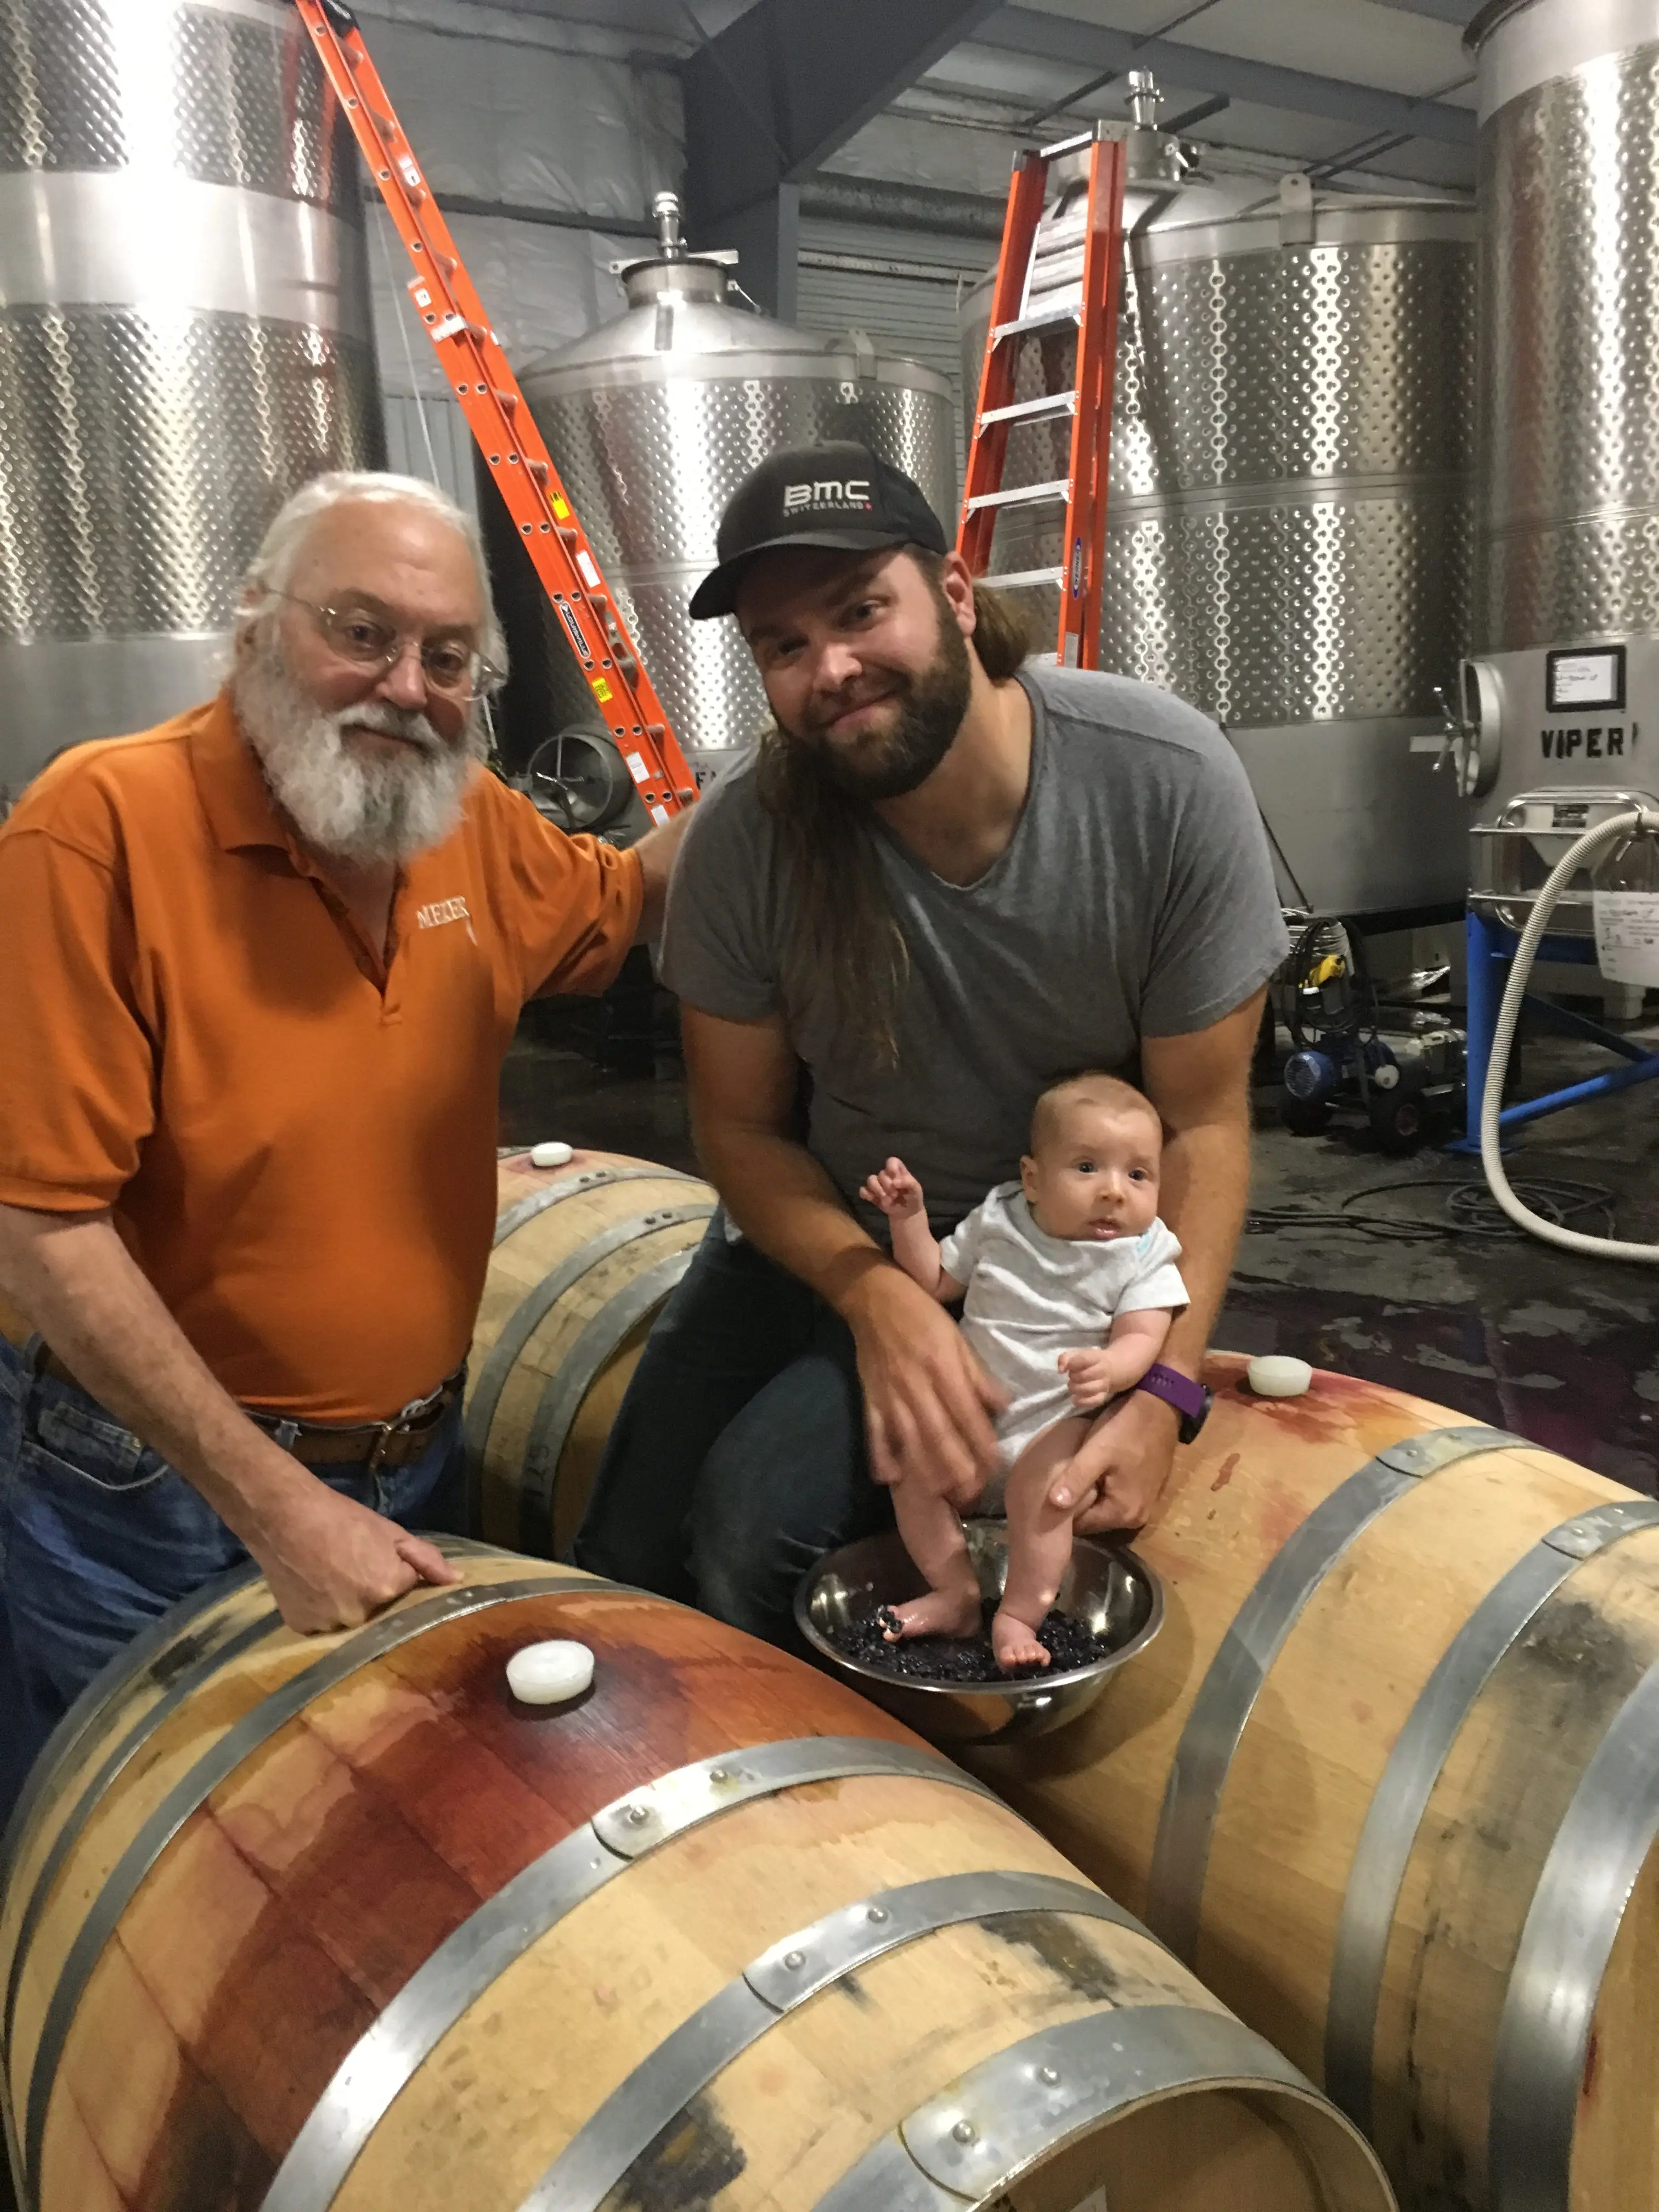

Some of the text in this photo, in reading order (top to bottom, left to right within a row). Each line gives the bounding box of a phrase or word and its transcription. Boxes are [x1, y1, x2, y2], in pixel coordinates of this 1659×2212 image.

[784, 481, 870, 507] BMC
[783, 501, 864, 517] SWITZERLAND
[1541, 727, 1624, 759] VIPER
